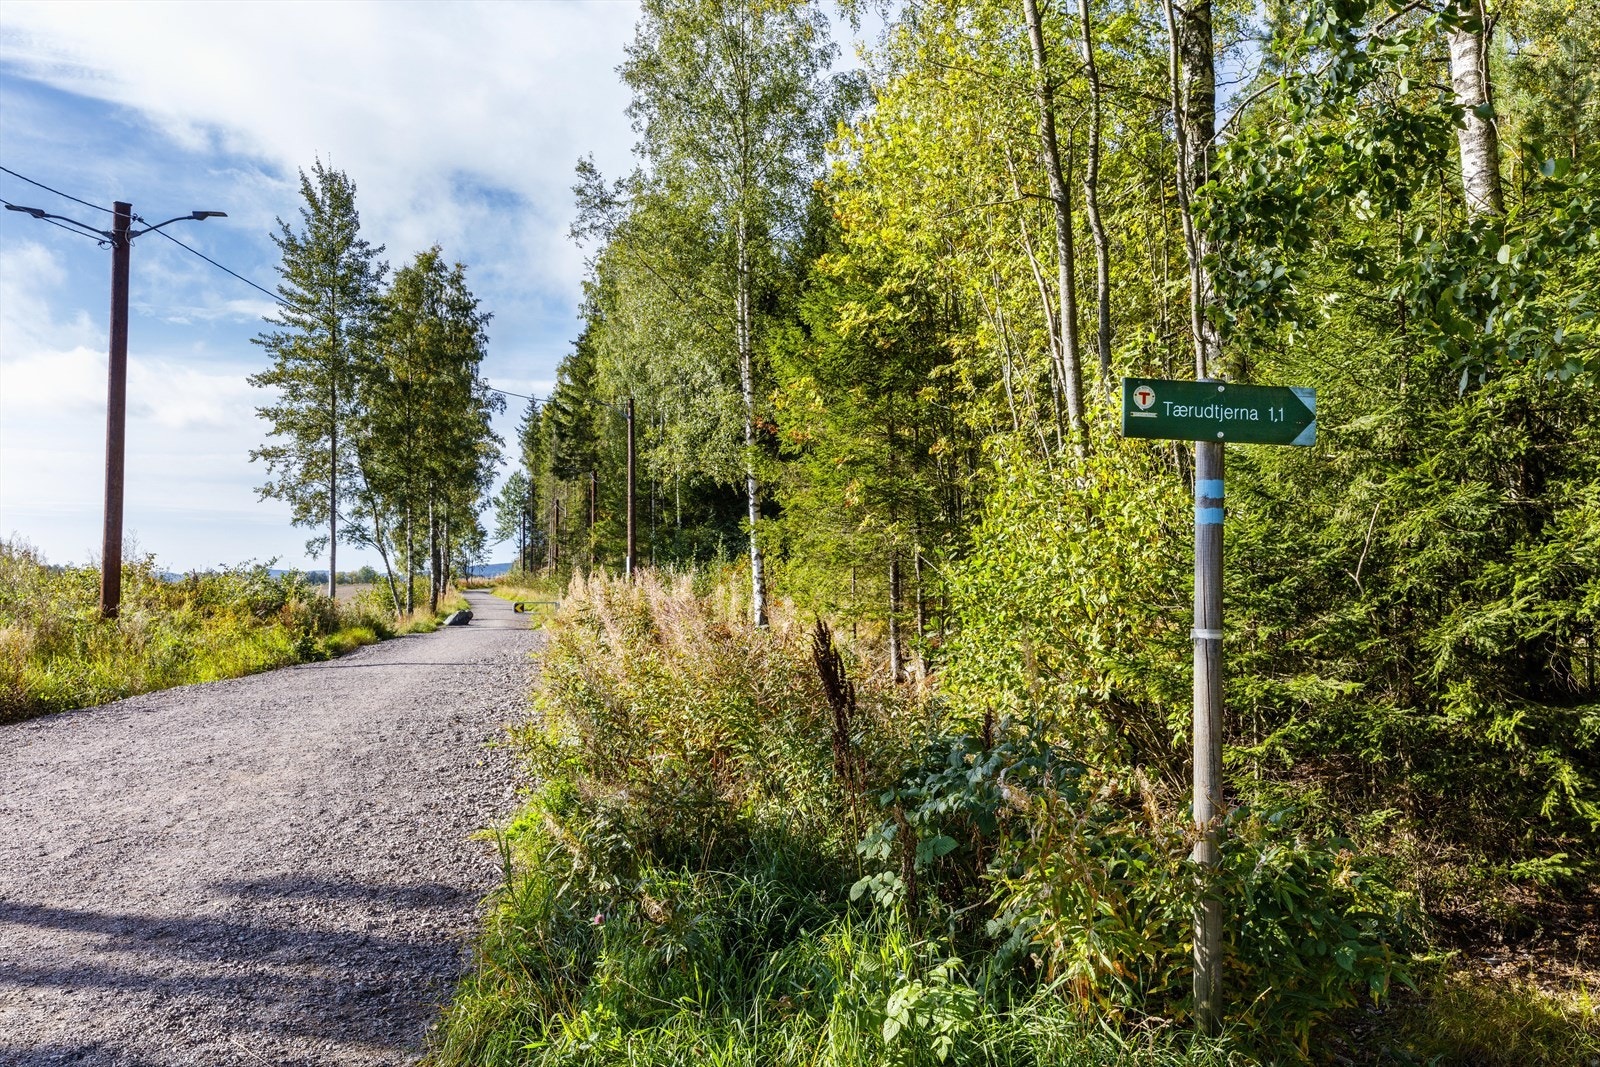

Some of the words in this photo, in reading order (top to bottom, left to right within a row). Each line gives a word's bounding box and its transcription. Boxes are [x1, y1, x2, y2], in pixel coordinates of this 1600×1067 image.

[1138, 392, 1151, 405] T
[1162, 401, 1259, 423] Tærudtjerna
[1268, 407, 1284, 423] 1,1
